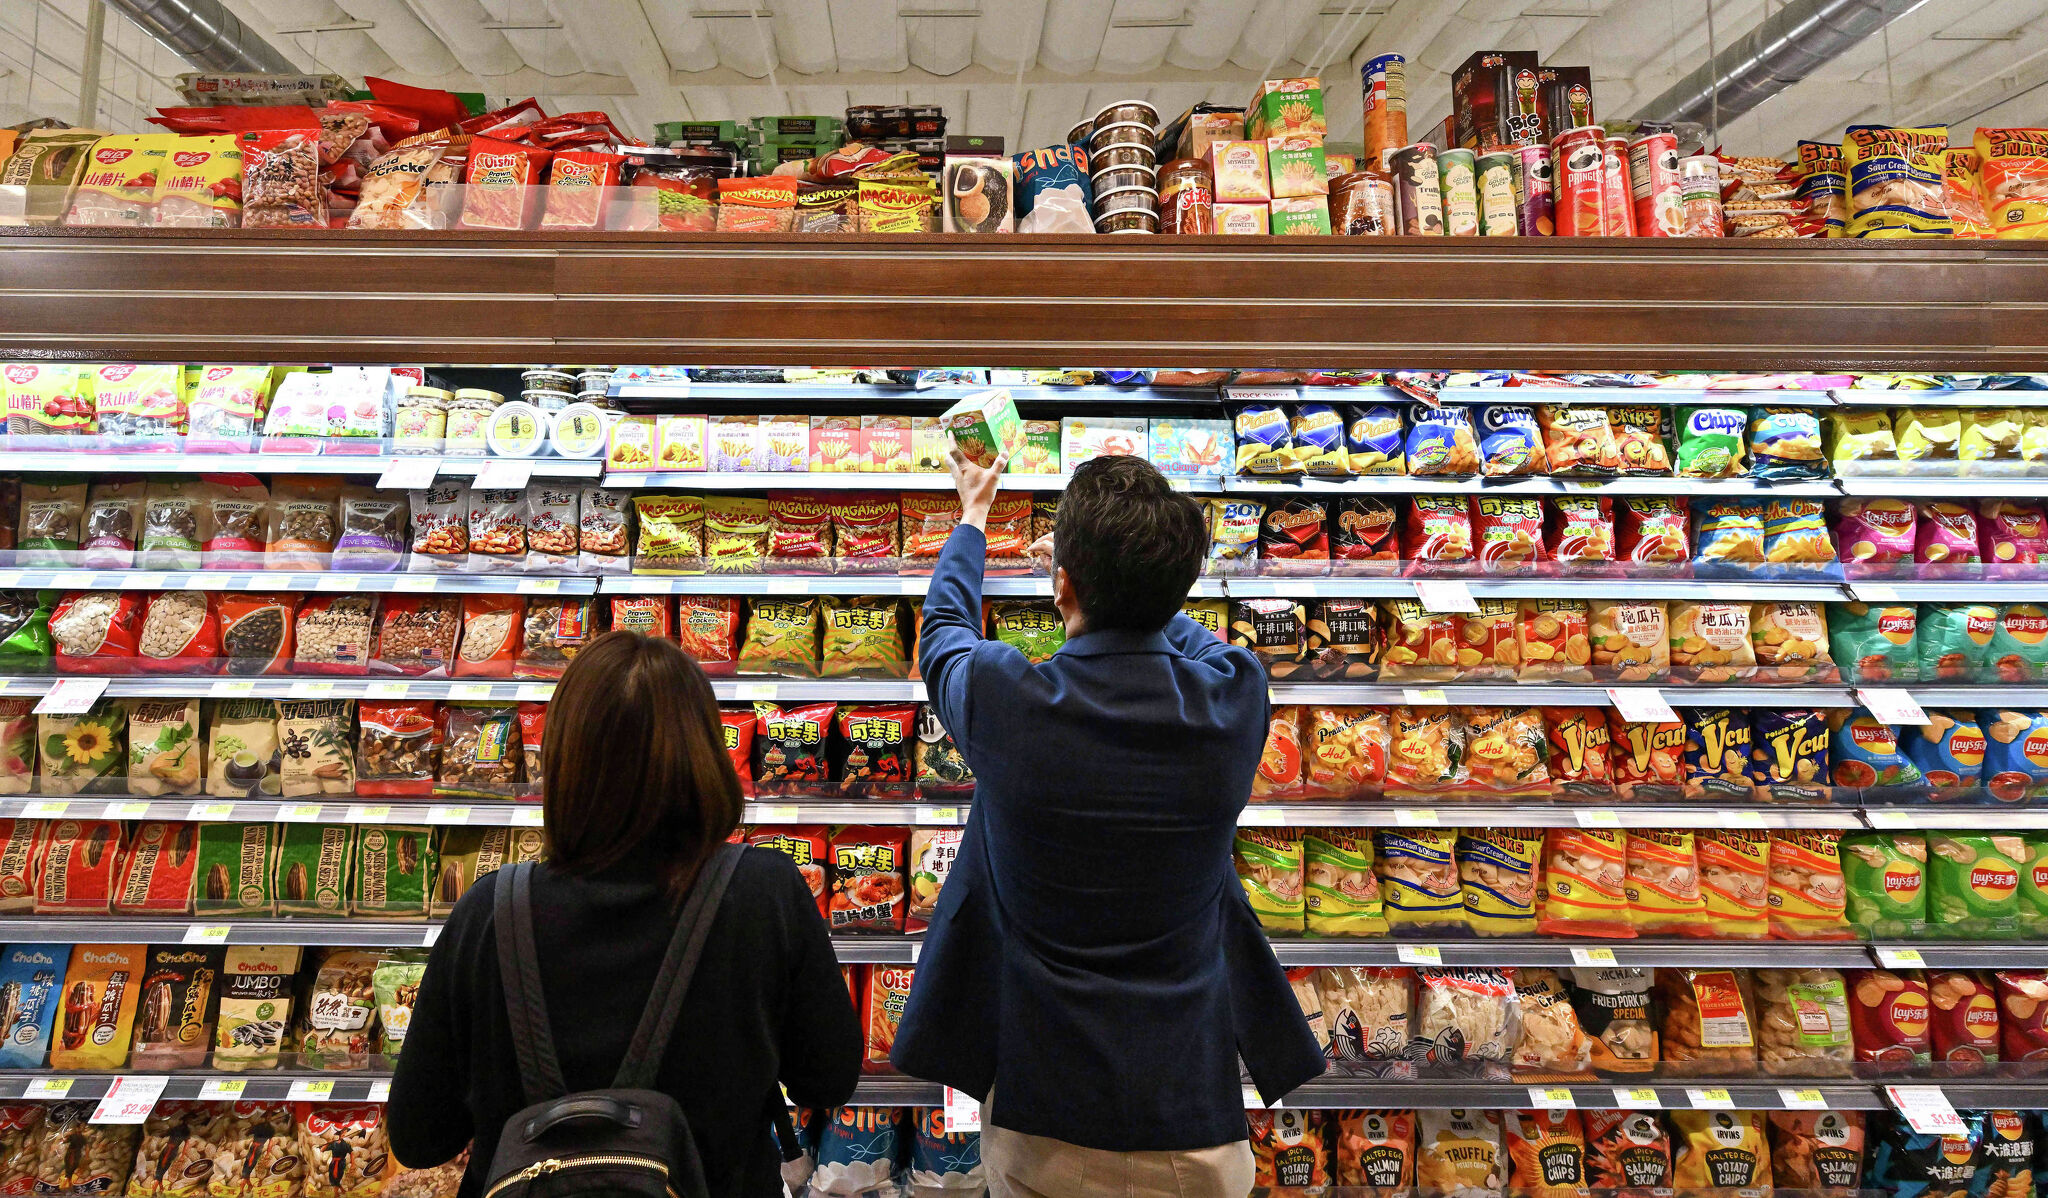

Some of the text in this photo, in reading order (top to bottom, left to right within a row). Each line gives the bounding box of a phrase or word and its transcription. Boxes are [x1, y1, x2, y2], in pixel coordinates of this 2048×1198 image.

[1508, 114, 1540, 131] BIG
[1511, 127, 1542, 141] ROLL
[1851, 129, 1949, 156] SHRIMP
[484, 155, 516, 169] Oishi
[1867, 160, 1887, 173] Sour
[488, 170, 511, 178] Prawn
[1567, 170, 1604, 185] PRINGLES
[481, 177, 514, 185] Crackers
[861, 189, 932, 204] NAGARAYA
[1232, 391, 1262, 399] STOCK
[1609, 408, 1656, 425] Chips
[1157, 461, 1199, 474] Sa Giang
[1306, 459, 1335, 467] CHEESE
[1370, 466, 1398, 474] CHEESE
[153, 501, 173, 509] PHONG
[216, 503, 255, 511] PHONG KEE
[288, 503, 328, 512] PHONG KEE
[353, 502, 393, 510] PHONG KEE
[769, 501, 832, 516] NAGARAYA
[832, 502, 899, 517] NAGARAYA
[1223, 504, 1261, 520] BOY
[1266, 508, 1326, 529] Piattos
[1339, 508, 1396, 531] Piattos
[344, 539, 382, 547] FIVE SPICE
[800, 535, 816, 543] SPICY
[870, 538, 884, 546] SPICY
[166, 541, 199, 551] GARLIC
[627, 610, 651, 618] Prawn
[692, 610, 716, 618] Prawn
[1620, 609, 1661, 624] 地瓜片
[1779, 602, 1817, 618] 地瓜片
[622, 616, 654, 625] Crackers
[687, 616, 719, 625] Crackers
[1329, 620, 1368, 633] 牛排口味
[1701, 613, 1746, 627] 地瓜片
[1882, 618, 1904, 631] Lay's
[2006, 617, 2026, 630] Lay's
[1256, 620, 1295, 635] 牛排口味
[1265, 635, 1286, 645] 洋芋片
[1338, 633, 1360, 642] 洋芋片
[1472, 716, 1505, 734] Seafood
[1764, 726, 1789, 740] Potato
[1854, 728, 1874, 742] Lay's
[1401, 741, 1427, 756] Hot
[1478, 741, 1504, 755] Hot
[1951, 737, 1973, 752] Lay's
[1321, 746, 1345, 760] Hot
[1771, 727, 1829, 779] Vcut
[256, 827, 267, 857] ROASTED
[333, 829, 345, 860] ROASTED
[1471, 840, 1487, 851] Sour
[53, 844, 72, 902] SUNFLOWER SEEDS
[131, 844, 160, 904] SUNFLOWER SEEDS
[241, 865, 254, 886] SEEDS
[1972, 872, 2017, 886] Lay's 乐事
[1886, 875, 1907, 890] Lay's
[12, 951, 53, 965] ChaCha
[82, 951, 129, 965] ChaCha
[156, 951, 207, 963] ChaCha
[237, 961, 278, 972] ChaCha
[232, 975, 281, 990] JUMBO
[1516, 979, 1550, 997] Squid
[1592, 994, 1639, 1007] FRIED PORK
[1613, 1007, 1647, 1020] SPECIAL
[1893, 1006, 1914, 1020] Lay's
[1967, 1010, 1984, 1023] Lay's
[121, 1103, 152, 1115] $2.99
[1450, 1121, 1474, 1131] IRVINS
[1930, 1113, 1962, 1126] $1.99
[1281, 1129, 1301, 1139] IRVINS
[1367, 1131, 1385, 1139] IRVINS
[1716, 1130, 1741, 1140] IRVINS
[1818, 1128, 1845, 1139] IRVINS
[1287, 1148, 1304, 1157] SPICY
[1362, 1150, 1403, 1163] SALTED EGG
[1444, 1146, 1494, 1163] TRUFFLE
[1633, 1147, 1654, 1156] SPICY
[1708, 1151, 1756, 1163] SALTED EGG
[1815, 1151, 1847, 1162] SALTED
[1276, 1155, 1315, 1166] SALTED EGG
[1546, 1153, 1574, 1167] POTATO
[1282, 1164, 1309, 1175] POTATO
[1367, 1160, 1400, 1175] SALMON
[1547, 1167, 1576, 1181] CHIPS
[1624, 1163, 1665, 1177] SALMON
[1716, 1162, 1749, 1174] POTATO
[1821, 1161, 1857, 1174] SALMON
[1283, 1175, 1309, 1186] CHIPS
[1374, 1174, 1396, 1186] SKIN
[1633, 1175, 1656, 1186] SKIN
[1718, 1173, 1747, 1186] CHIPS
[1828, 1173, 1851, 1186] SKIN
